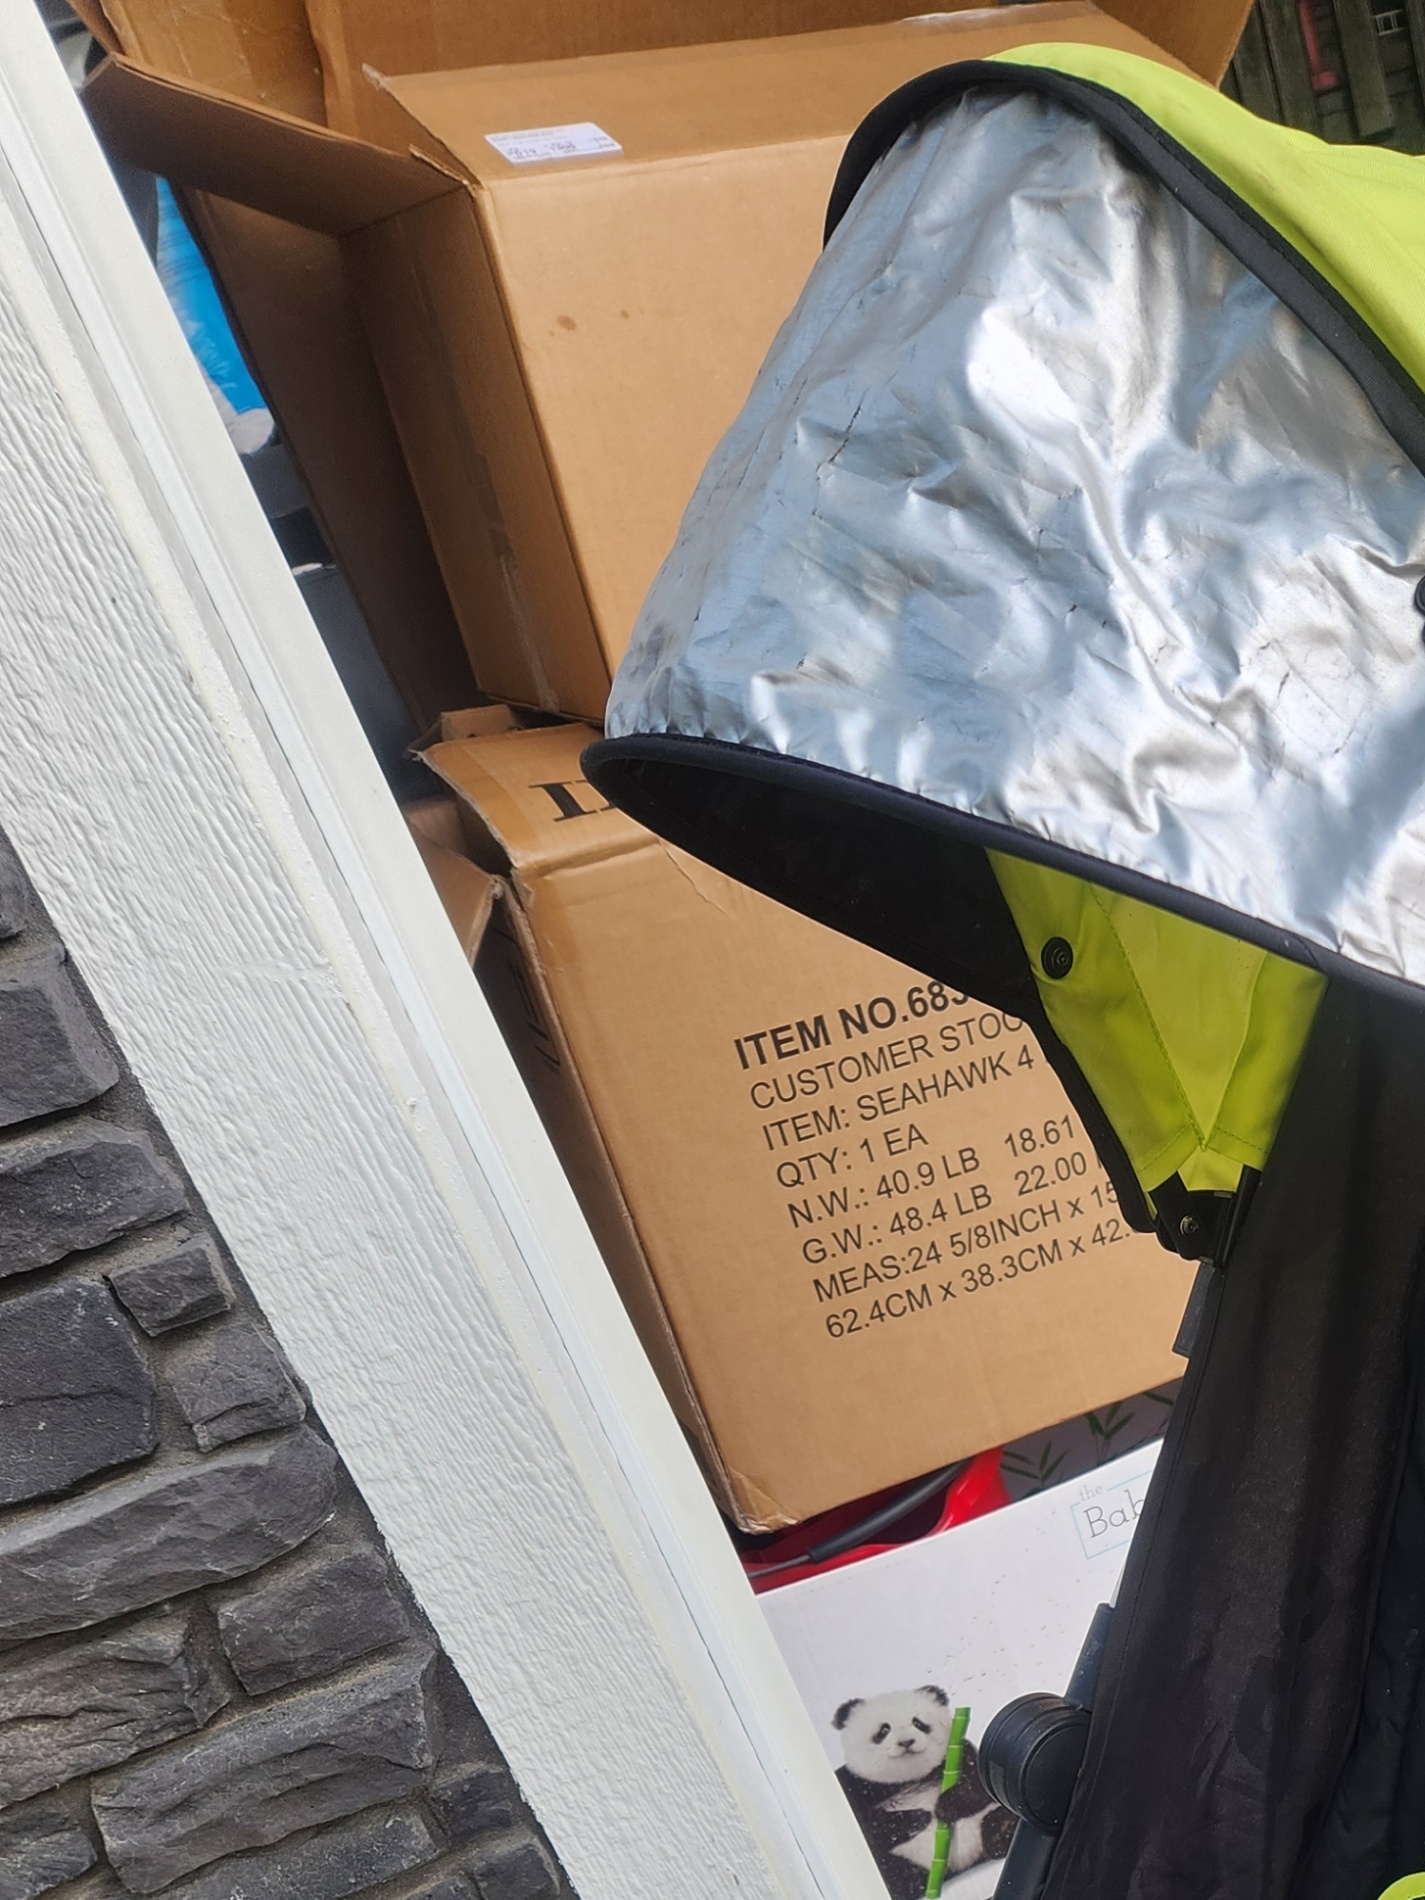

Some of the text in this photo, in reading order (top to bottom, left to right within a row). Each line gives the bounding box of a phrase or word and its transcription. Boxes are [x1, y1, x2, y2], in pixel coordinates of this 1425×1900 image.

[734, 1015, 832, 1070] ITEM
[750, 1034, 934, 1109] CUSTOMER
[762, 1044, 1034, 1151] ITEM: SEAHAWK 4
[776, 1123, 929, 1188] QTY: 1 EA
[788, 1114, 1075, 1228] N.W.: 40.9 LB 18.61
[803, 1151, 1087, 1264] G.W.: 48.4 LB 22.00
[812, 1243, 942, 1302] MEAS:24
[950, 1201, 1061, 1258] 5/8INCH
[1069, 1198, 1085, 1219] x
[826, 1218, 1134, 1338] 62.4CM x 38.3CM x 42.
[1080, 1485, 1103, 1501] the
